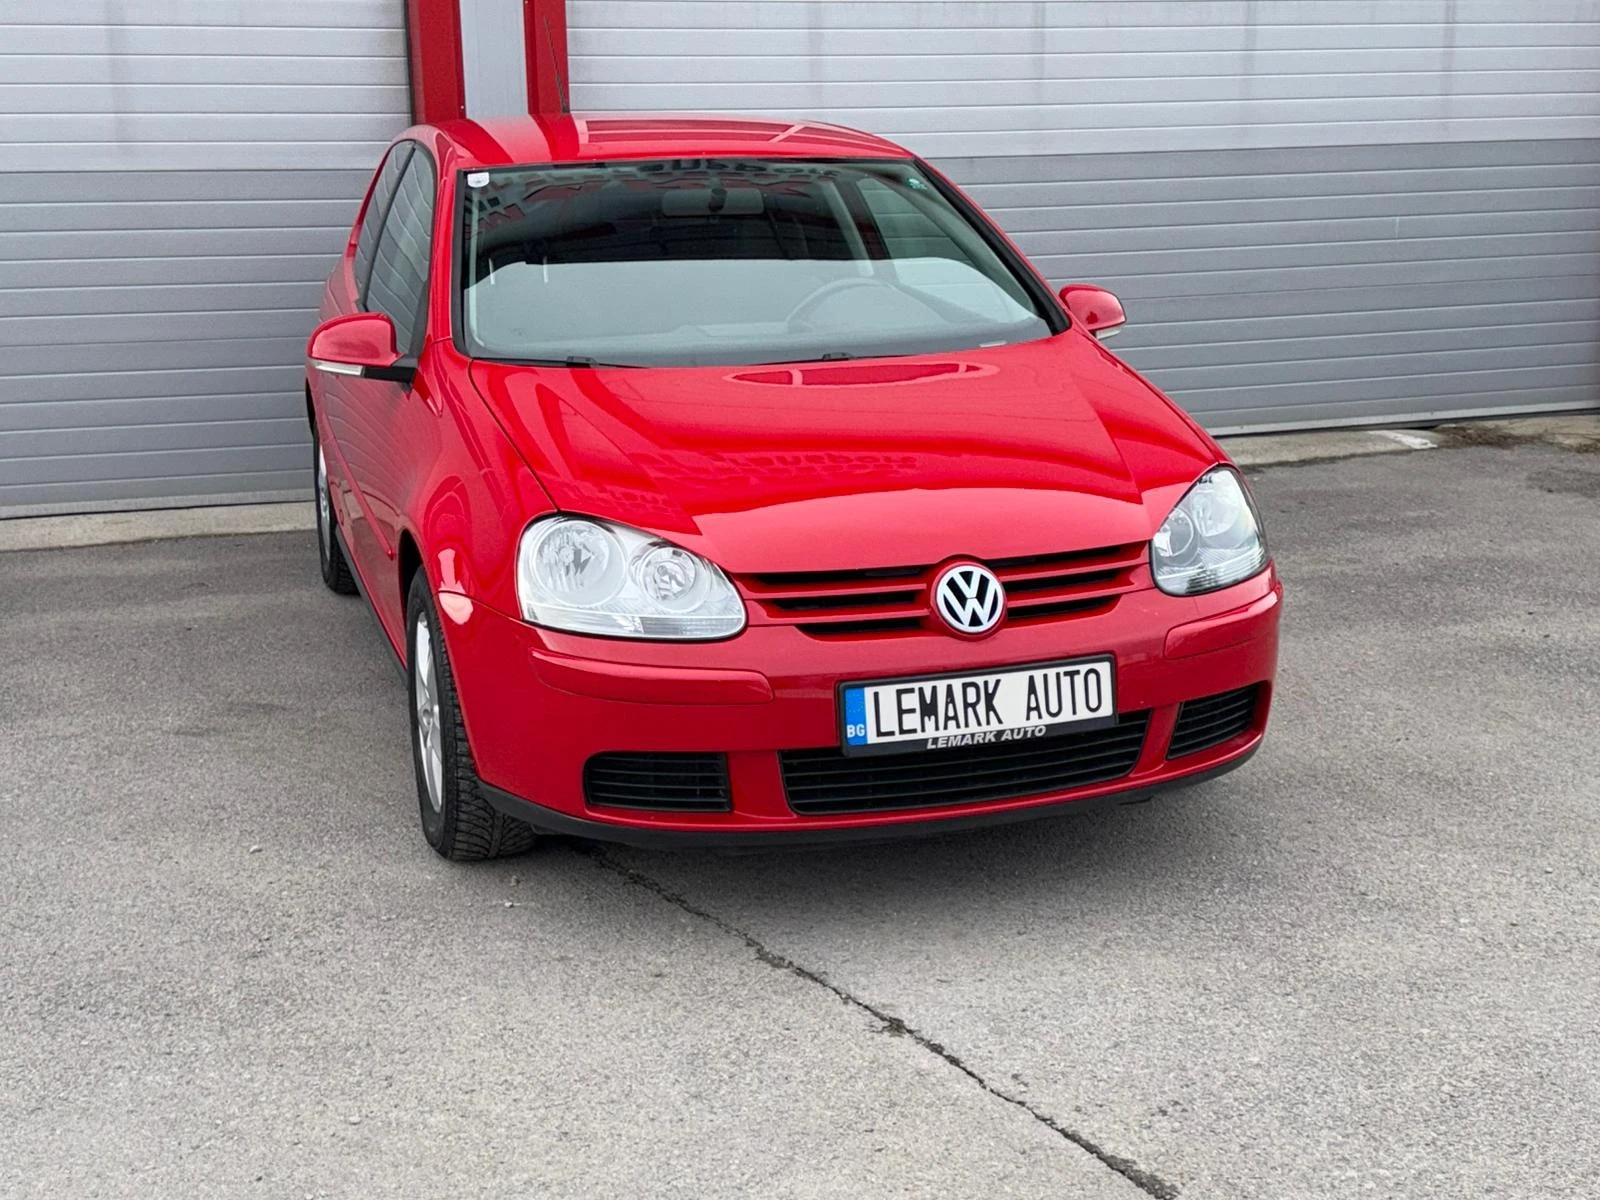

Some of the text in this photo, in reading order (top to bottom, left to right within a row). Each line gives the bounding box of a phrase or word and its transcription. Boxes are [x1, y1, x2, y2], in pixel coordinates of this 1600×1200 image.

[938, 565, 1003, 633] VW
[873, 668, 1102, 738] LEMARK AUTO
[847, 724, 866, 738] BG
[926, 725, 1047, 750] LEMARK AUTO
